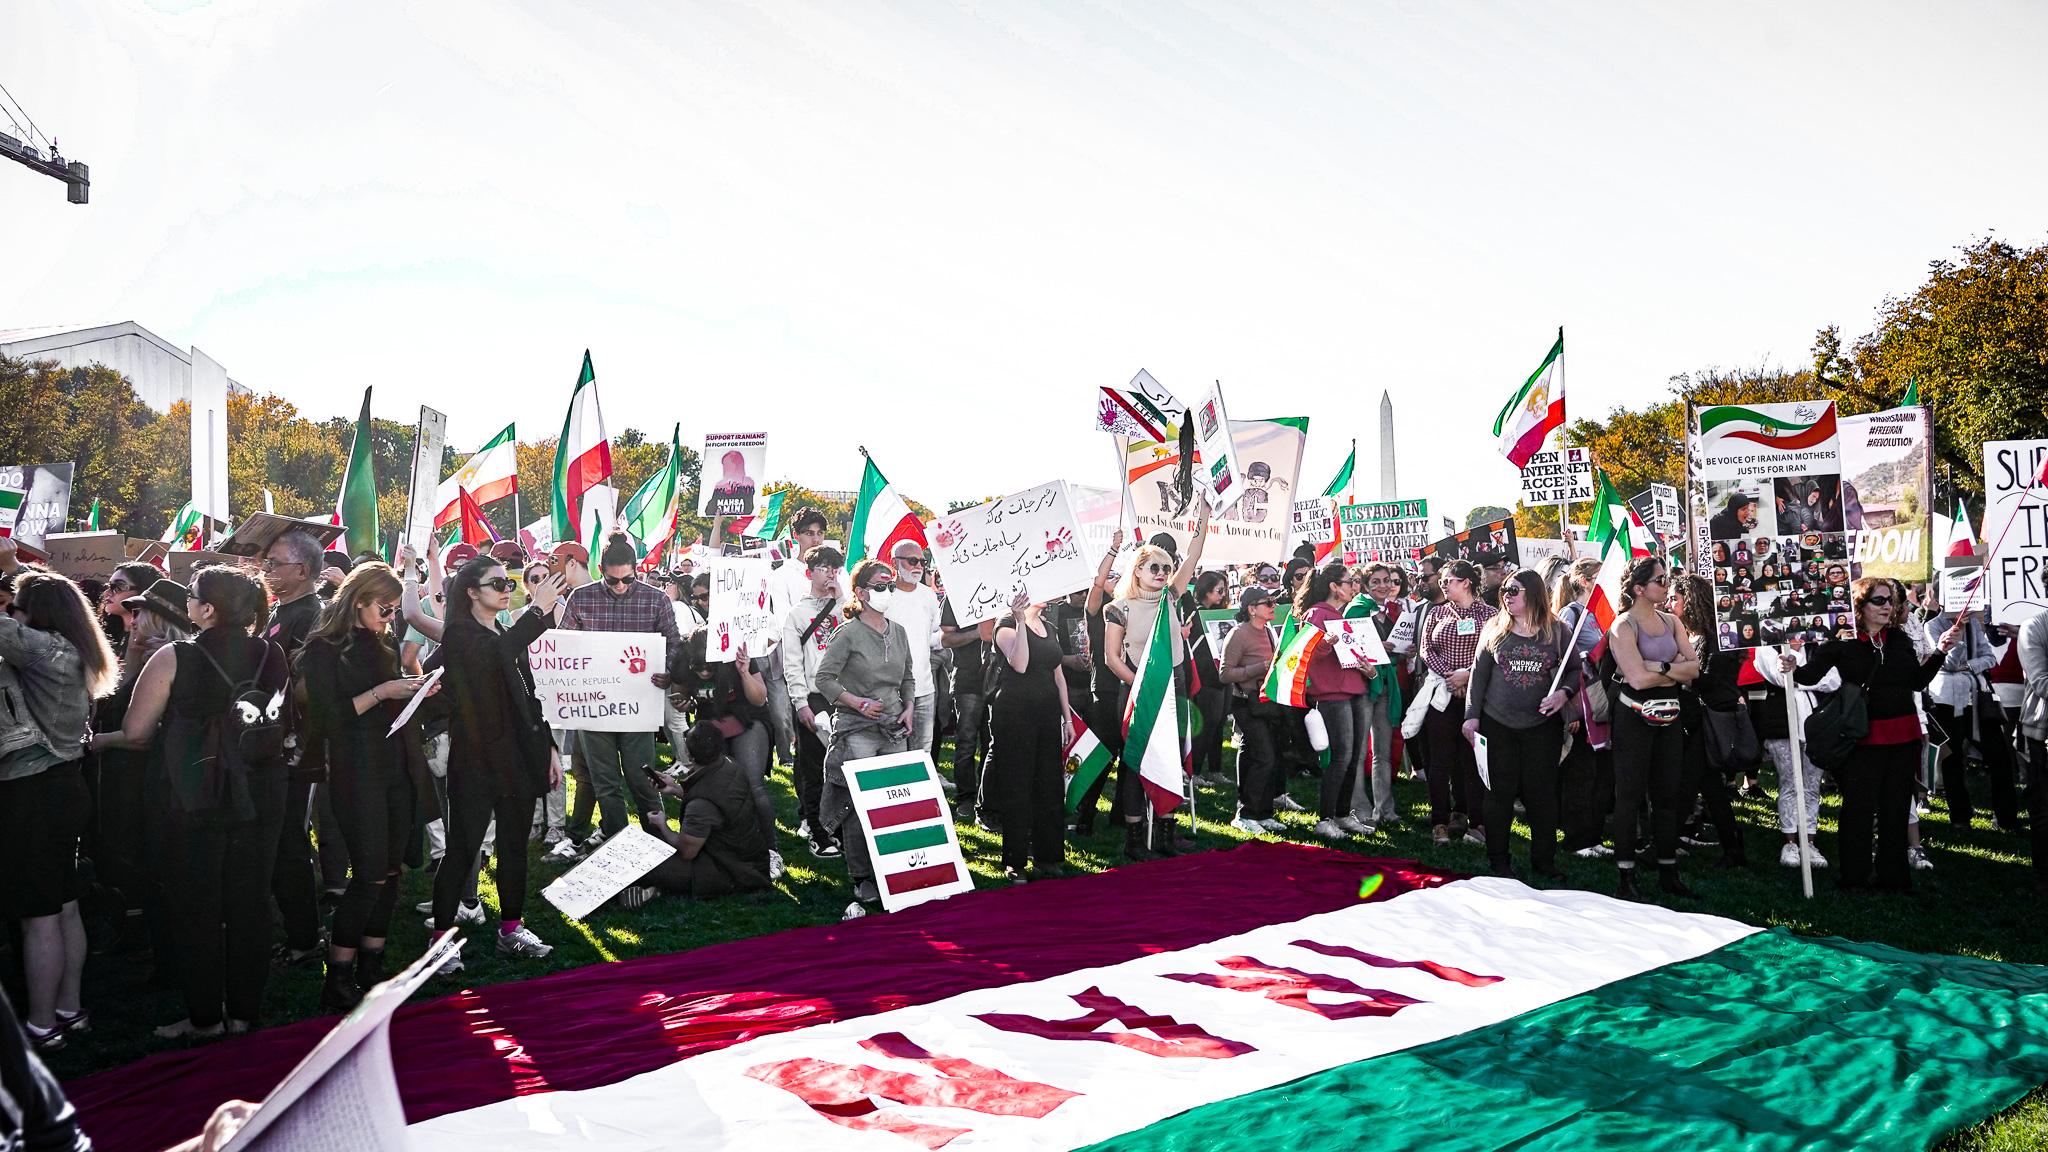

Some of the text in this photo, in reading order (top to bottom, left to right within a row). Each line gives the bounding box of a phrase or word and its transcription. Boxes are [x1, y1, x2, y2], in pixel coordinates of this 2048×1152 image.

[1133, 402, 1157, 425] LIFE
[1869, 425, 1904, 435] #FREEIRAN
[1867, 437, 1914, 447] #REVOLUTION
[1526, 452, 1559, 466] PEN
[1706, 451, 1836, 466] BE VOICE OF IRANIAN MOTHERS
[1520, 462, 1591, 479] INTERNET
[1737, 464, 1807, 476] JUSTIS FOR IRAN
[1522, 475, 1578, 491] ACCESS
[1530, 491, 1547, 502] IN
[1652, 485, 1672, 498] WOMEN
[717, 499, 745, 507] MAHSA
[1294, 499, 1321, 511] REEZE
[1666, 504, 1677, 516] LIFE
[23, 503, 60, 519] NNA
[1309, 508, 1328, 520] IRGC
[1345, 502, 1420, 521] I STAND IN
[17, 519, 57, 536] OW?
[1188, 520, 1222, 534] RIME
[1225, 527, 1267, 539] ADVOCACY
[1292, 520, 1322, 533] ASSETS
[1346, 520, 1429, 538] SOLIDARITY
[1307, 530, 1330, 542] IN US
[972, 538, 998, 557] جنایت
[1356, 549, 1412, 563] IN IRAN
[717, 568, 745, 594] HOW
[737, 591, 759, 608] MANY
[732, 614, 751, 631] MORE
[528, 639, 556, 654] UN
[529, 657, 592, 671] UNICEF
[1509, 660, 1543, 669] KINDNESS
[535, 676, 621, 687] SLAMIC REPUBLIC
[539, 691, 606, 704] S KILLING
[558, 702, 639, 719] CHILDREN
[886, 788, 911, 800] IRAN
[908, 850, 928, 868] ایران
